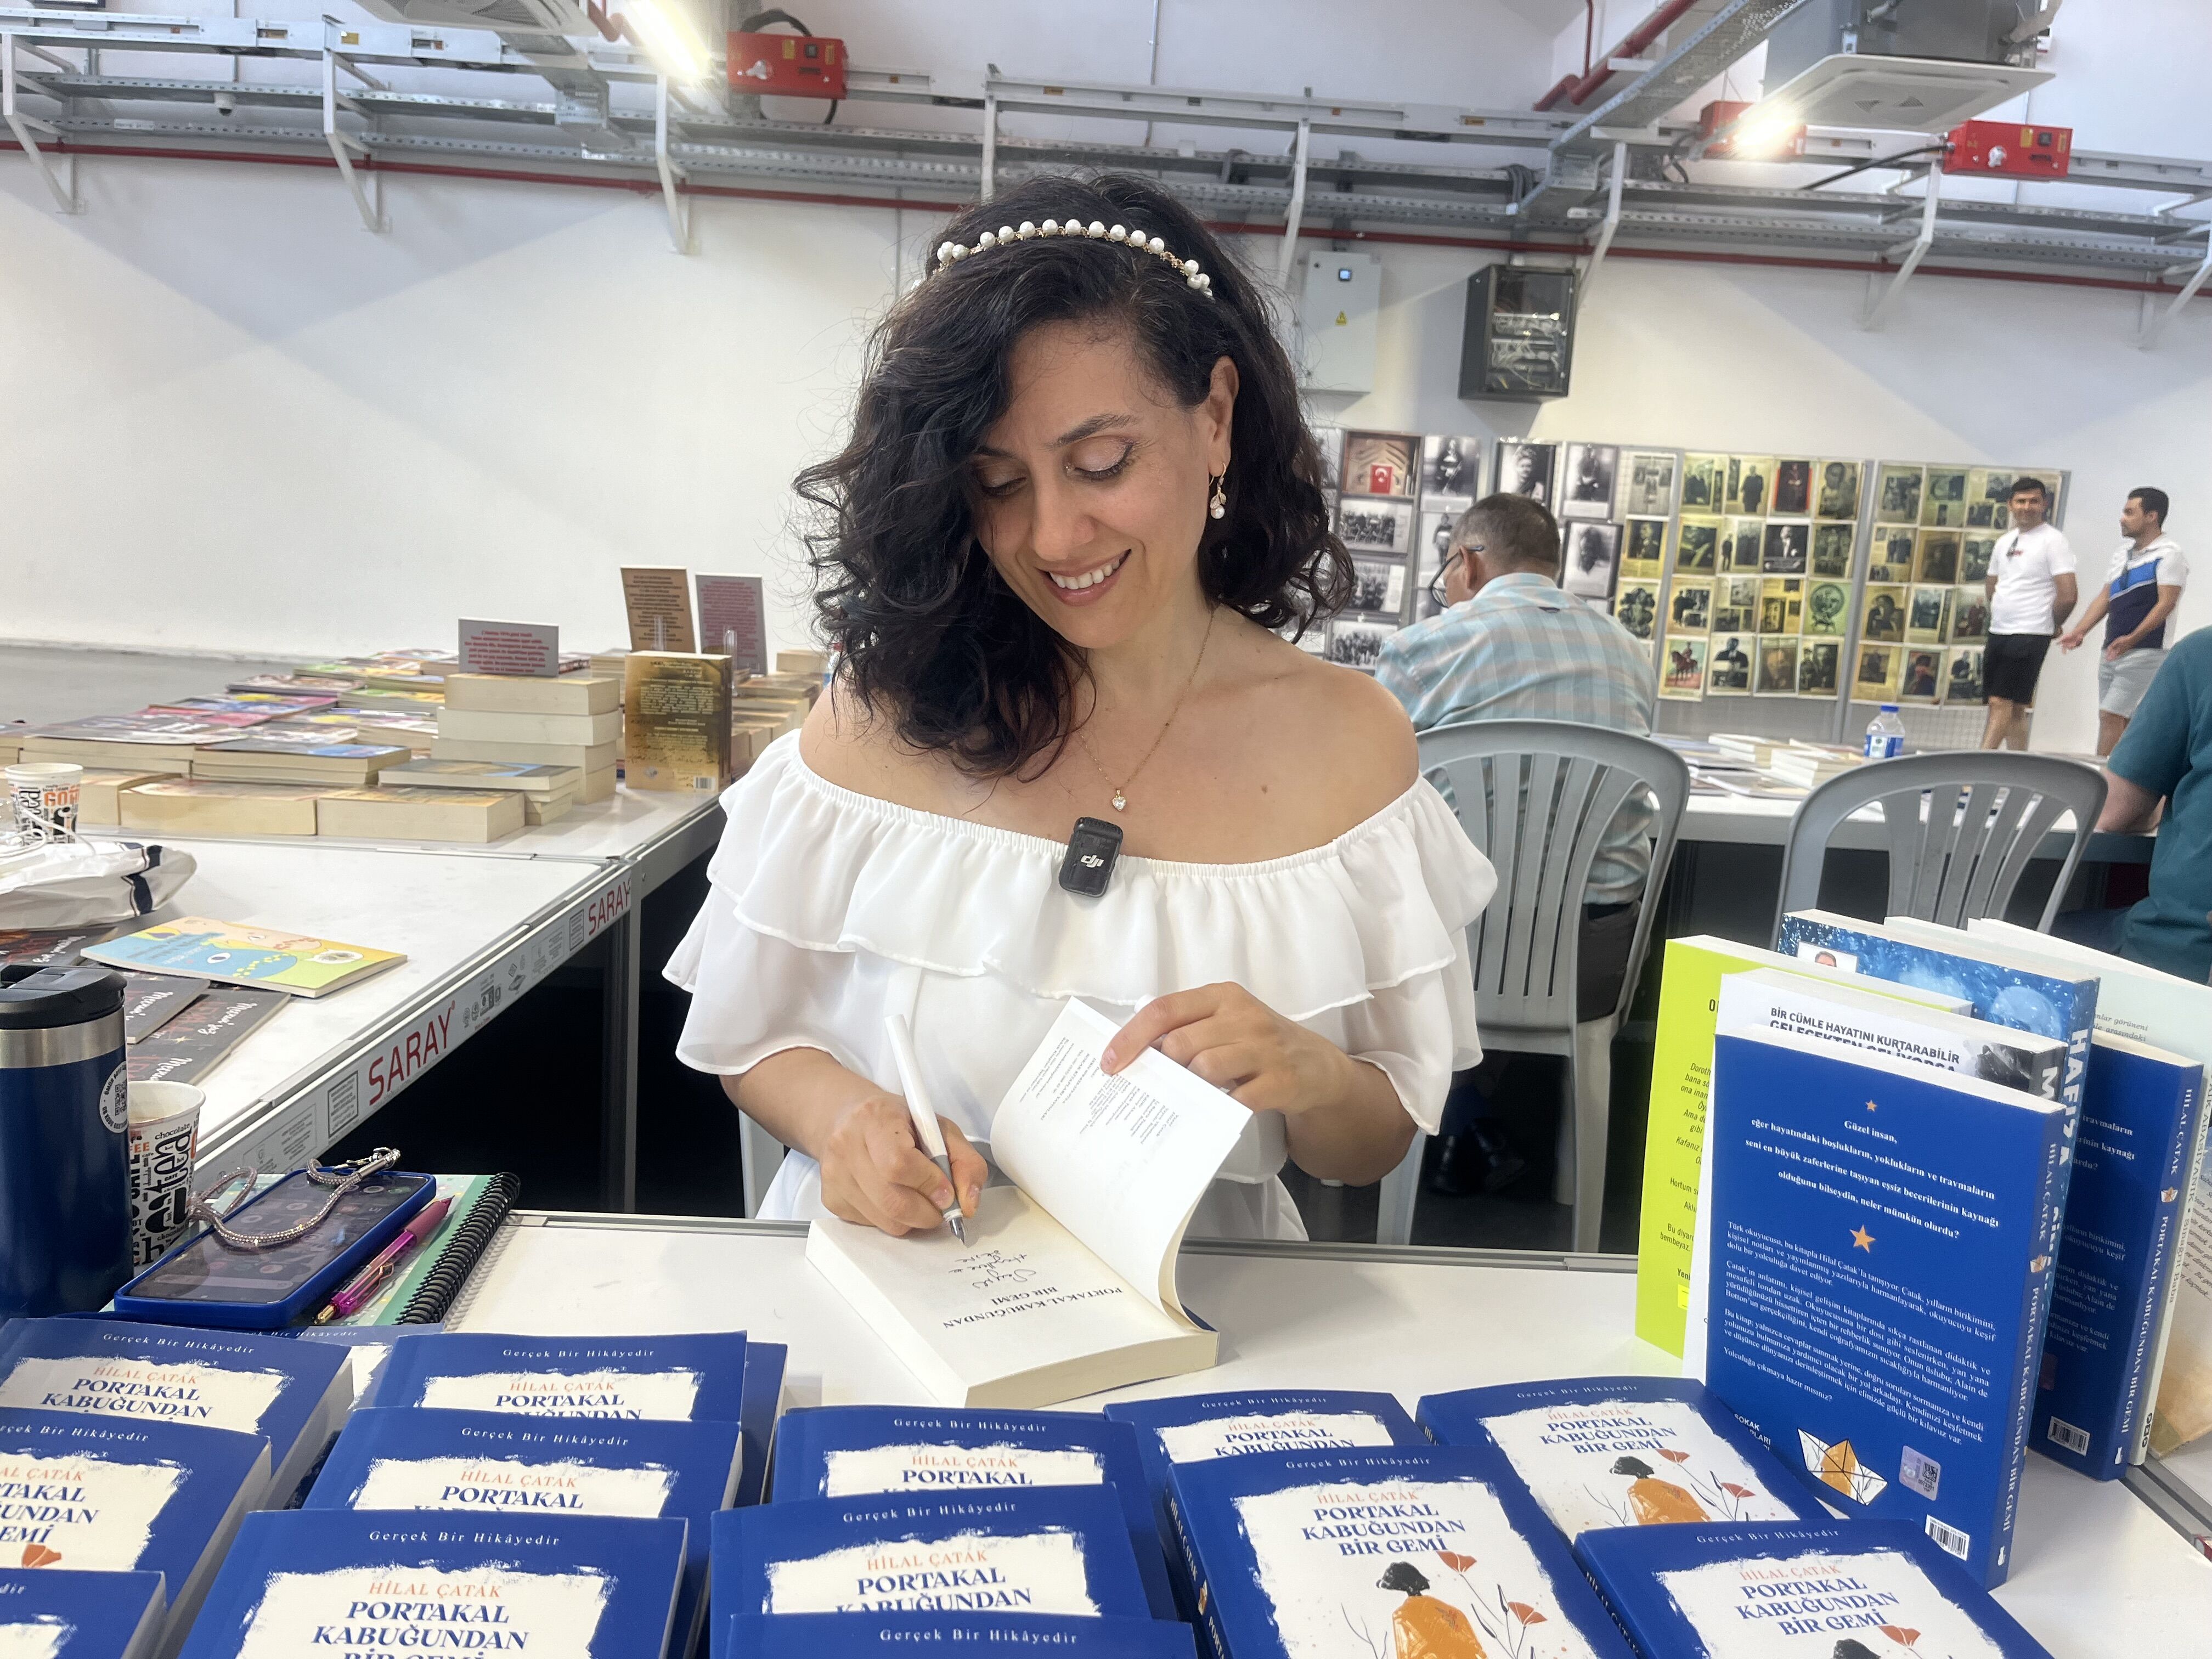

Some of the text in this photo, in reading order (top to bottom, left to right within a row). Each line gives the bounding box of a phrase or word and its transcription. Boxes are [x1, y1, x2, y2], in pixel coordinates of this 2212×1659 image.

[589, 881, 630, 935] SARAY
[1771, 1007, 1787, 1020] BİR
[1790, 1010, 1824, 1029] CÜMLE
[1826, 1021, 1874, 1043] HAYATINI
[1876, 1035, 1960, 1064] KURTARABİLİR
[369, 1008, 452, 1105] SARAY
[1690, 1063, 1711, 1076] Doroth
[1685, 1073, 1701, 1085] bana
[1681, 1085, 1708, 1099] ona inan
[1683, 1109, 1698, 1120] Ama
[155, 1123, 190, 1140] chocolate
[1689, 1124, 1702, 1134] gibi
[1844, 1120, 1897, 1143] Güzel insan,
[1676, 1136, 1700, 1151] Kafanız
[1751, 1118, 1994, 1199] eğer hayatındaki boşlukların, yoklukların ve travmaların
[1670, 1177, 1692, 1193] Hortum
[1745, 1139, 1761, 1149] seni
[1775, 1146, 1801, 1161] büyük
[1802, 1156, 1848, 1175] zaferlerine
[1849, 1170, 1880, 1186] taşıyan
[1881, 1182, 1901, 1193] eşsiz
[1903, 1187, 1959, 1214] becerilerinin
[1961, 1206, 1999, 1227] kaynağı
[1778, 1170, 1959, 1238] olduğunu bilseydin, neler mümkün olurdu?
[1667, 1223, 1675, 1233] Bu
[1660, 1232, 1690, 1252] bembeyaz.
[1726, 1240, 1832, 1285] dolu bir yolculuğa davet ediyor.
[1727, 1230, 1748, 1244] kişisel
[1751, 1240, 1773, 1253] notları
[1786, 1253, 1829, 1275] yayınlanmış
[1831, 1270, 1869, 1290] yazılarıyla
[1871, 1284, 1926, 1315] harmanlayarak,
[1928, 1310, 1971, 1333] okuyucuyu
[1974, 1327, 1996, 1341] keşif
[943, 1287, 1124, 1329] PORTAKAL KABUĞUNDAN
[93, 1366, 199, 1384] HİLAL ÇATAK
[1723, 1346, 1832, 1400] Yolculuğa çıkmaya hazır mısınız?
[72, 1378, 201, 1401] PORTAKAL
[510, 1381, 615, 1393] HİLAL ÇATAK
[41, 1393, 212, 1418] KABUĞUNDAN
[495, 1394, 625, 1407] PORTAKAL
[1548, 1408, 1633, 1420] HİLAL ÇATAK
[1228, 1420, 1317, 1432] HİLAL ÇATAK
[1547, 1417, 1652, 1431] PORTAKAL
[40, 1425, 150, 1443] Bir Hikâyedir
[1224, 1429, 1333, 1443] PORTAKAL
[1539, 1427, 1678, 1445] KABUĞUNDAN
[1214, 1439, 1356, 1457] KABUĞUNDAN
[1572, 1438, 1664, 1454] BİR GEMİ
[912, 1455, 1018, 1469] HİLAL ÇATAK
[27, 1468, 84, 1481] ÇATAK
[460, 1470, 576, 1488] HİLAL ÇATAK
[902, 1469, 1032, 1486] PORTAKAL
[0, 1483, 86, 1502] TAKAL
[439, 1486, 584, 1509] PORTAKAL
[1317, 1491, 1419, 1505] HİLAL ÇATAK
[1312, 1504, 1440, 1521] PORTAKAL
[0, 1524, 54, 1543] EMİ
[369, 1531, 560, 1546] Gerçek Bir Hikâyedir
[1301, 1520, 1466, 1541] KABUĞUNDAN
[1338, 1534, 1449, 1556] BİR GEMİ
[867, 1550, 988, 1572] HİLAL ÇATAK
[856, 1567, 1006, 1596] PORTAKAL
[1739, 1565, 1842, 1582] HİLAL ÇATAK
[369, 1580, 501, 1599] HİLAL ÇATAK
[1739, 1577, 1867, 1599] PORTAKAL
[346, 1601, 510, 1623] PORTAKAL
[1734, 1592, 1900, 1620] KABUĞUNDAN
[1776, 1609, 1890, 1636] BİR GEMİ
[311, 1624, 529, 1650] KABUĞUNDAN
